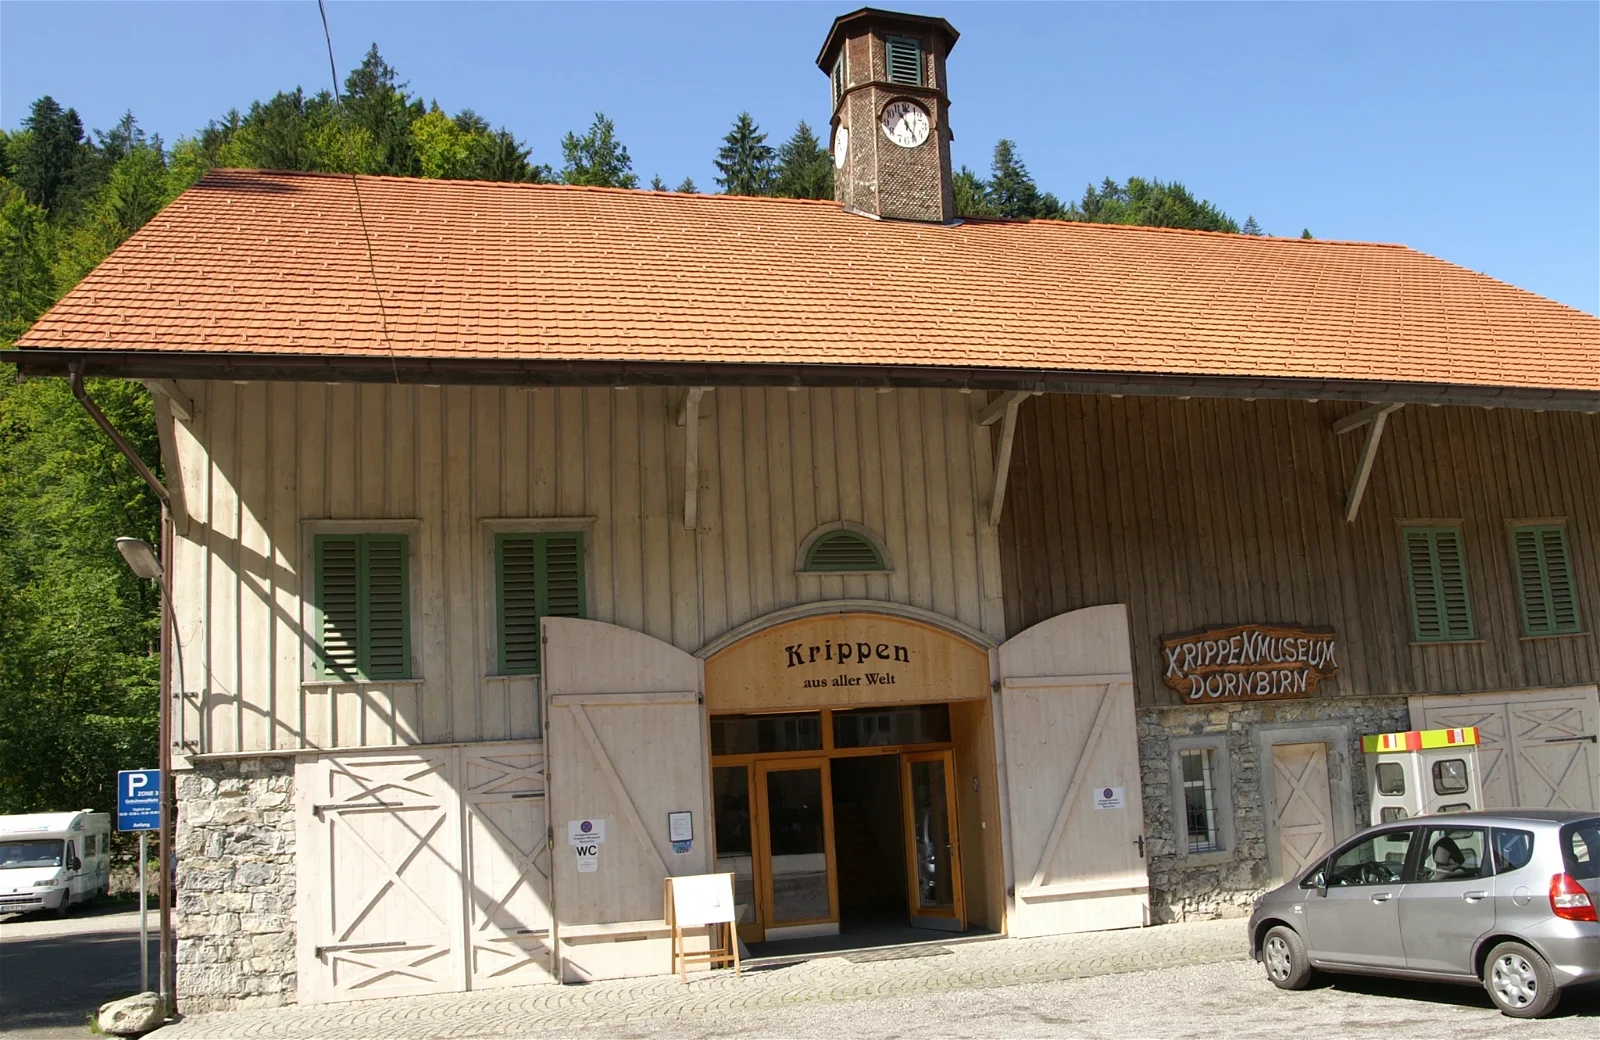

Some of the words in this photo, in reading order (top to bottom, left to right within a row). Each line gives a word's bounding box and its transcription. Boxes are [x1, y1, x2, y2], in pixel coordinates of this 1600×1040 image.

[886, 109, 894, 118] 10
[884, 118, 889, 126] 9
[922, 122, 928, 131] 3
[889, 127, 894, 136] 8
[897, 134, 902, 143] 7
[904, 136, 910, 145] 6
[785, 640, 910, 668] Krippen
[1165, 630, 1338, 678] KRIPPENMUSEUM
[804, 677, 828, 688] aus
[832, 674, 862, 687] aller
[865, 672, 896, 686] Welt
[1188, 669, 1310, 700] DORNBIRN
[128, 774, 148, 798] P
[576, 845, 597, 856] WC
